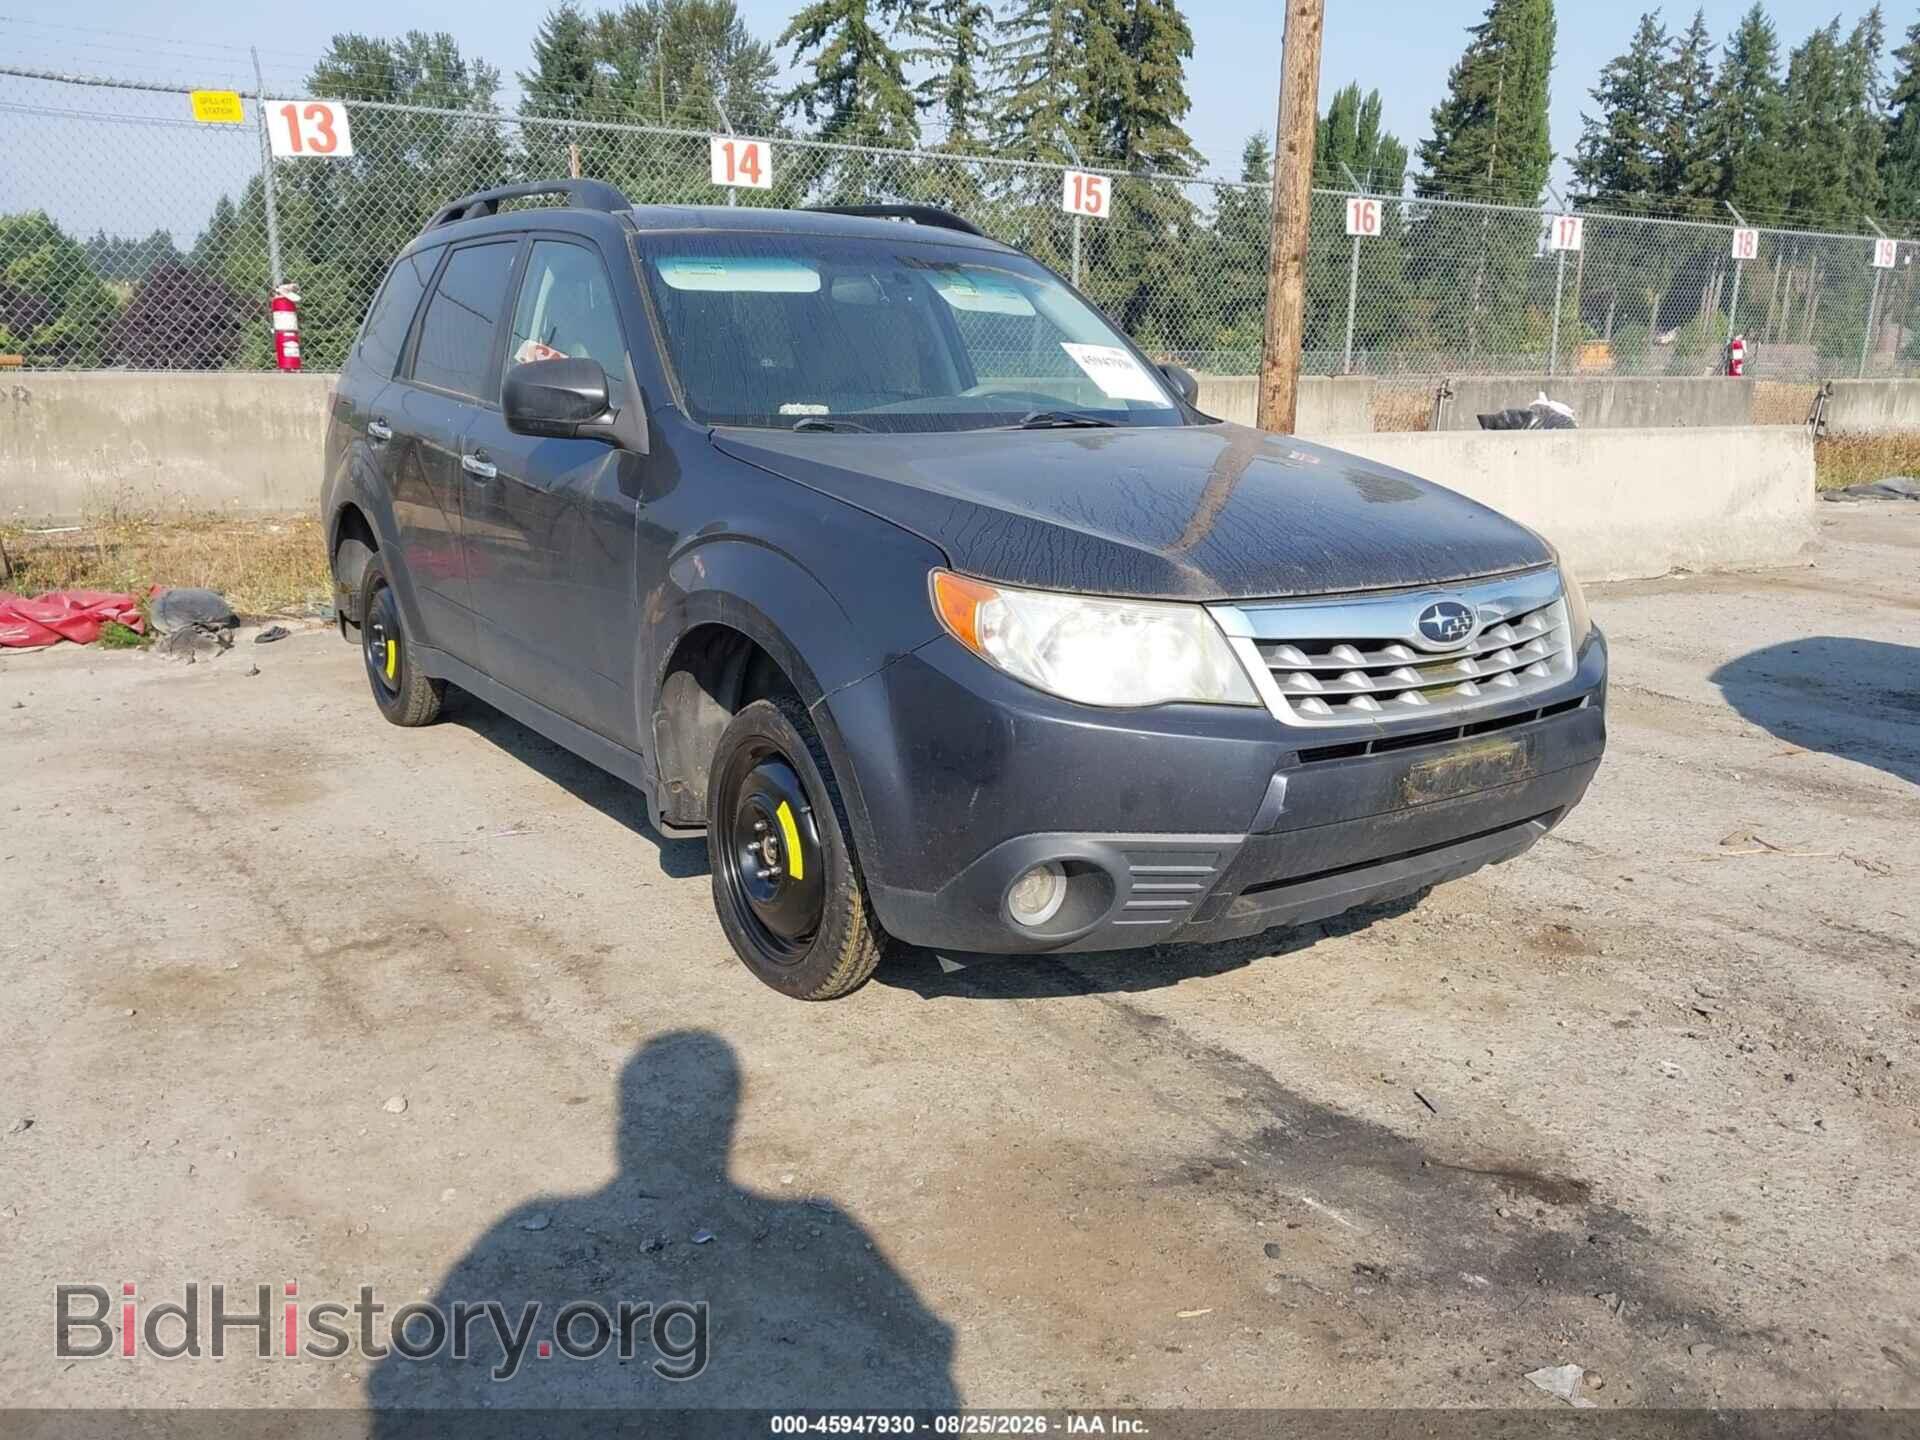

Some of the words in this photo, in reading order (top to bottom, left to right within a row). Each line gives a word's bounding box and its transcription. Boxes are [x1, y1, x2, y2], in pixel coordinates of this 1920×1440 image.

[280, 103, 337, 153] 13
[722, 142, 762, 184] 14
[1072, 175, 1103, 213] 15
[1353, 201, 1375, 233] 16
[1559, 219, 1576, 247] 17
[1738, 231, 1754, 257] 18
[1880, 241, 1893, 265] 19
